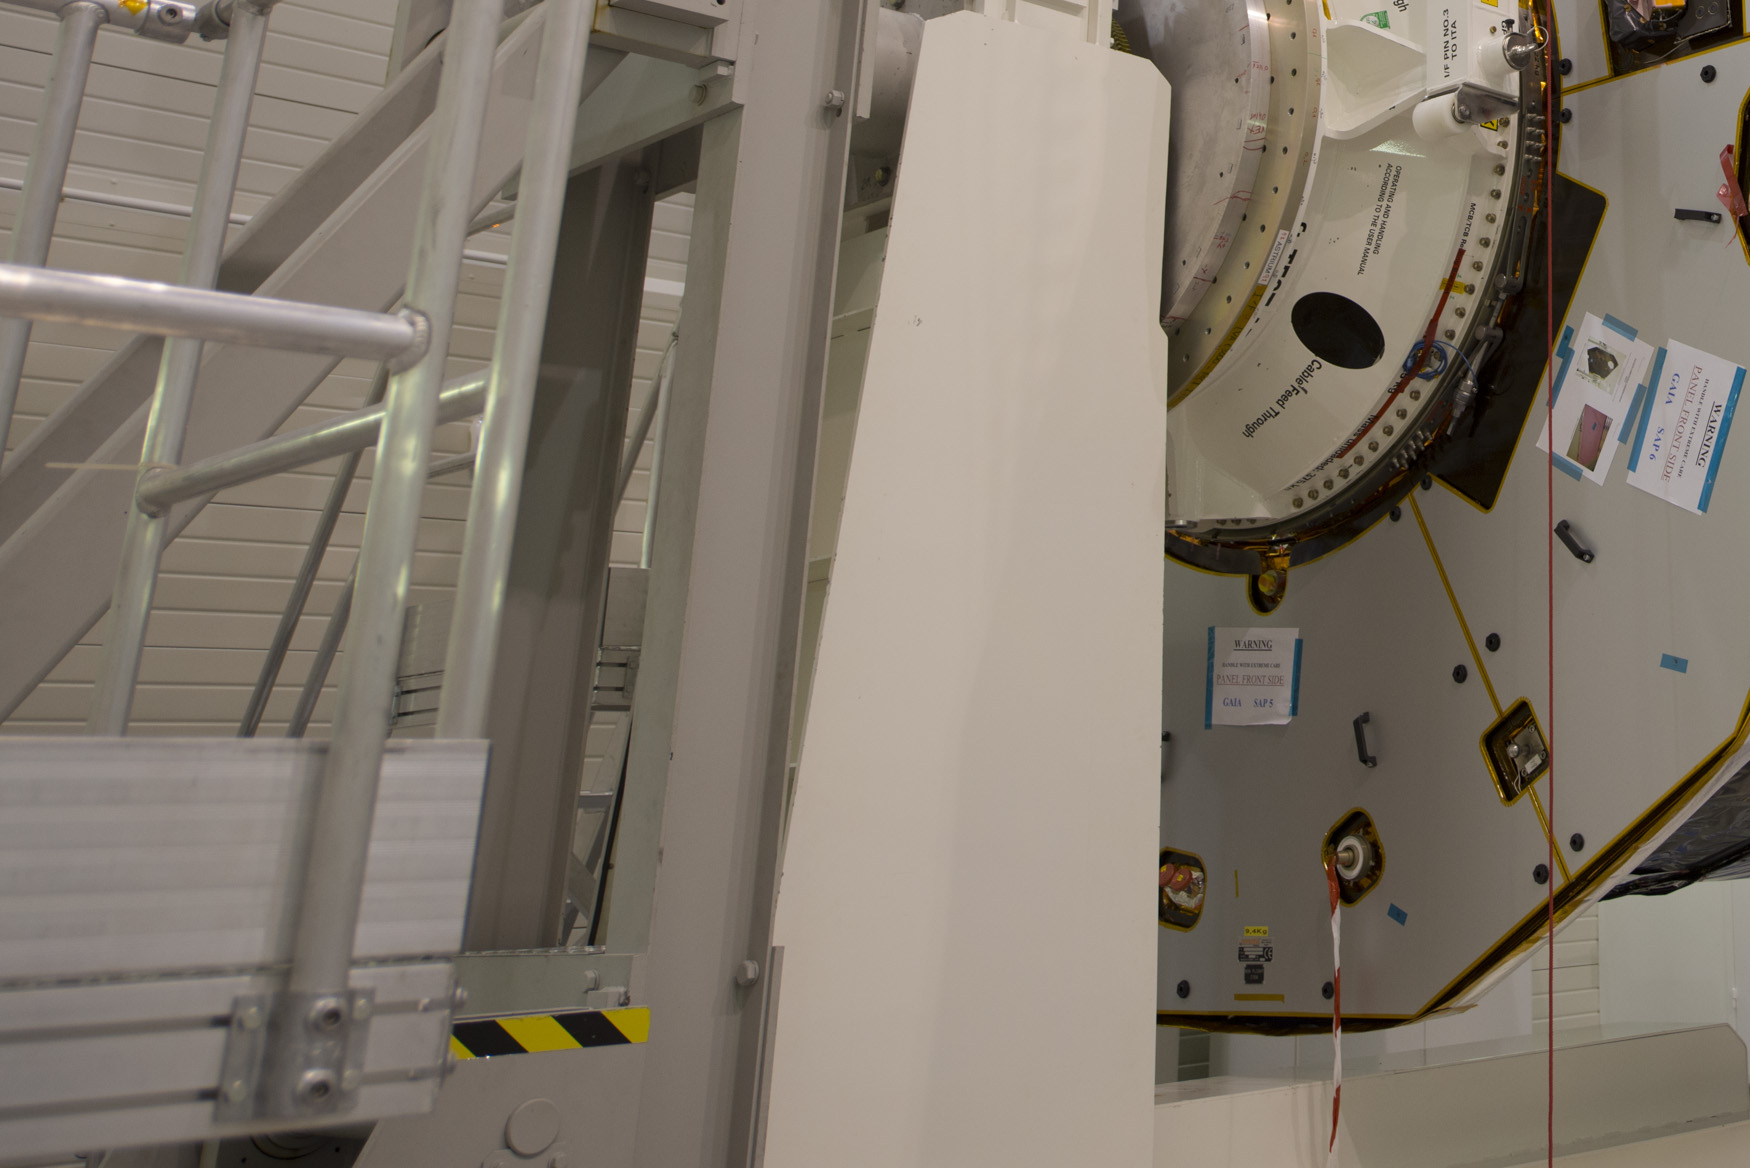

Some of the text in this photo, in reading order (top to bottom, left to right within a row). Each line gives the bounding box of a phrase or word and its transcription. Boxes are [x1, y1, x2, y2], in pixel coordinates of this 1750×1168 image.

[1442, 8, 1450, 36] NO.3
[1451, 42, 1458, 61] TO
[1357, 162, 1394, 276] ACCORDING TO THE USER MANUAL
[1372, 165, 1402, 255] OPERATING AND HANDLING
[1462, 202, 1476, 238] MCB/TCB
[1265, 240, 1282, 274] ASTRIUM
[1241, 358, 1322, 439] Cable Feed Through
[1649, 372, 1681, 461] GAIA SAP 6
[1664, 364, 1703, 482] PANEL FRONT SIDE
[1677, 378, 1710, 478] HANDLE WITH EXTREME CARE
[1697, 404, 1723, 468] WARNING
[1234, 639, 1273, 649] WARNING
[1216, 674, 1285, 685] PANEL FRONT SIDE
[1223, 697, 1274, 708] GAIA SAP 5
